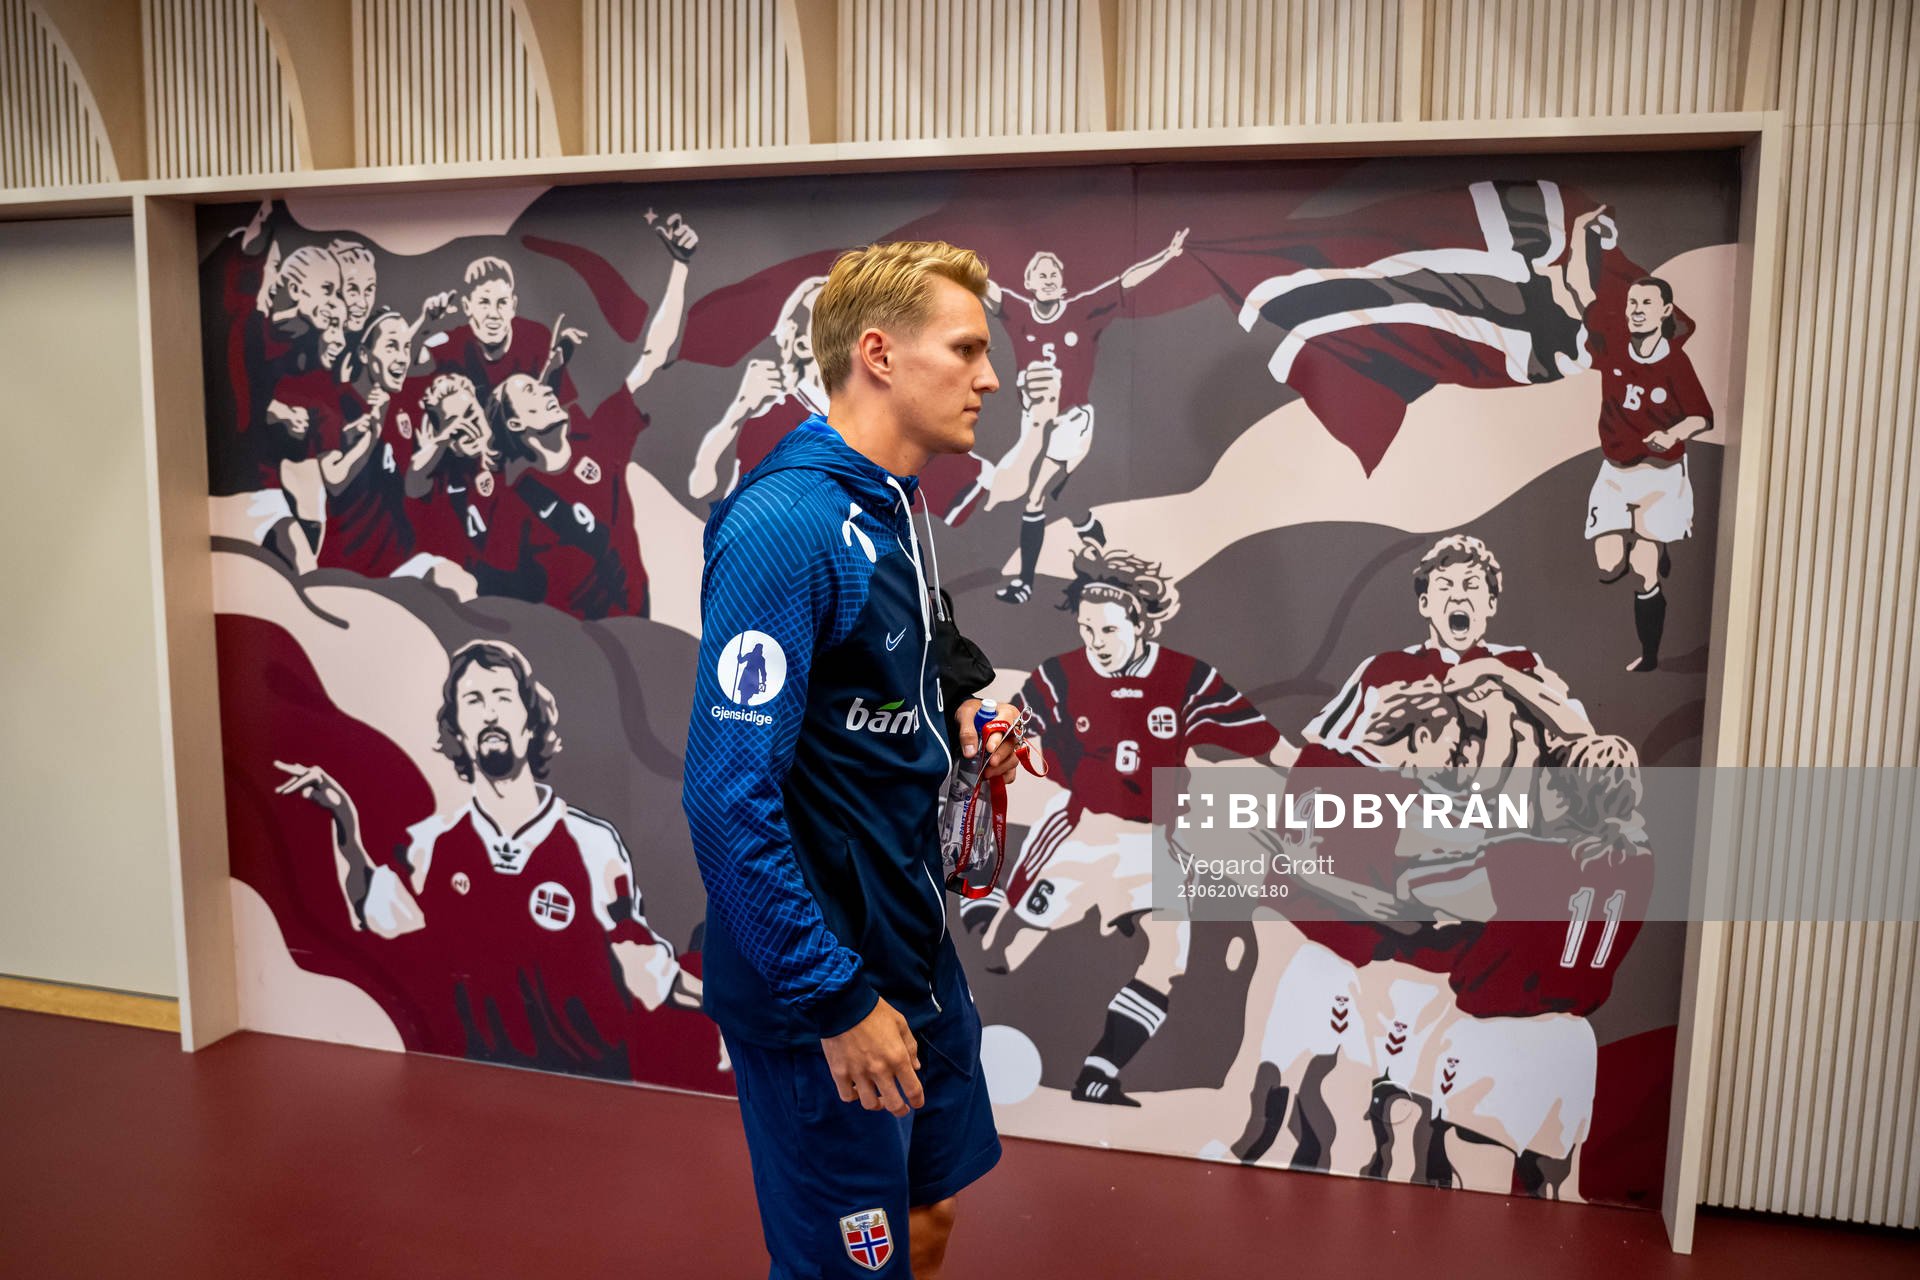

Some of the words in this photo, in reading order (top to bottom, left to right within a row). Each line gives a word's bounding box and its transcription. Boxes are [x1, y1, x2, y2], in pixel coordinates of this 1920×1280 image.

[382, 442, 396, 474] 4
[571, 502, 597, 534] 9
[711, 705, 773, 726] Gjensidige
[1115, 740, 1141, 775] 6
[1026, 878, 1056, 915] 6
[1560, 886, 1626, 969] 11
